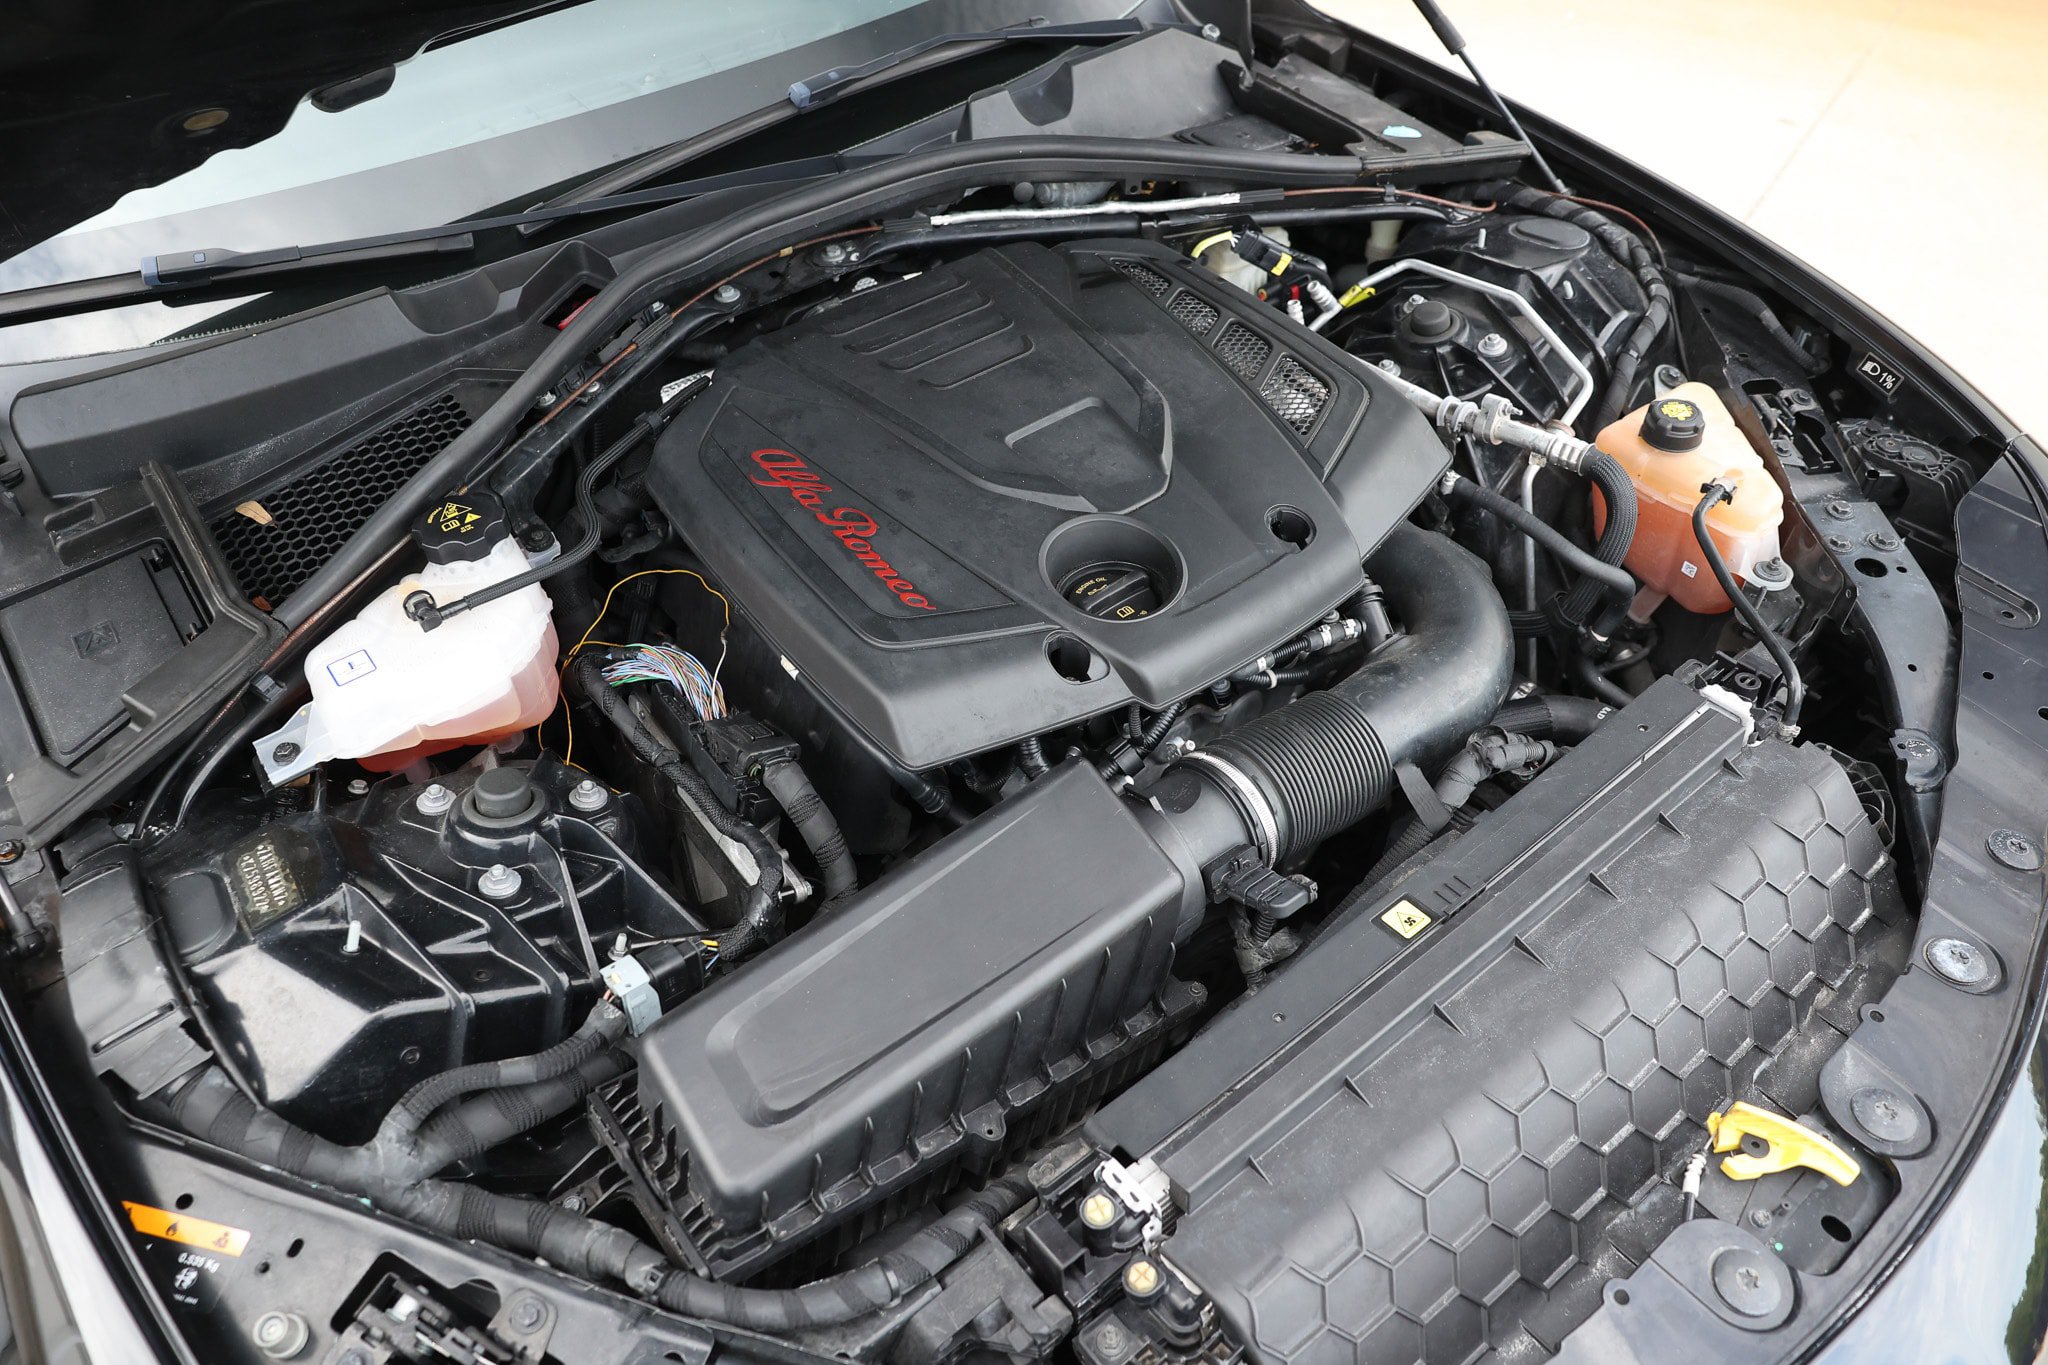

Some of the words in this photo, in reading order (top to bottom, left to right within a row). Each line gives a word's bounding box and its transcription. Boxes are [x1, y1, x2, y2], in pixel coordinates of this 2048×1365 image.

[1879, 372, 1896, 389] 1%
[750, 448, 833, 513] Alfa
[816, 507, 937, 611] Romeo
